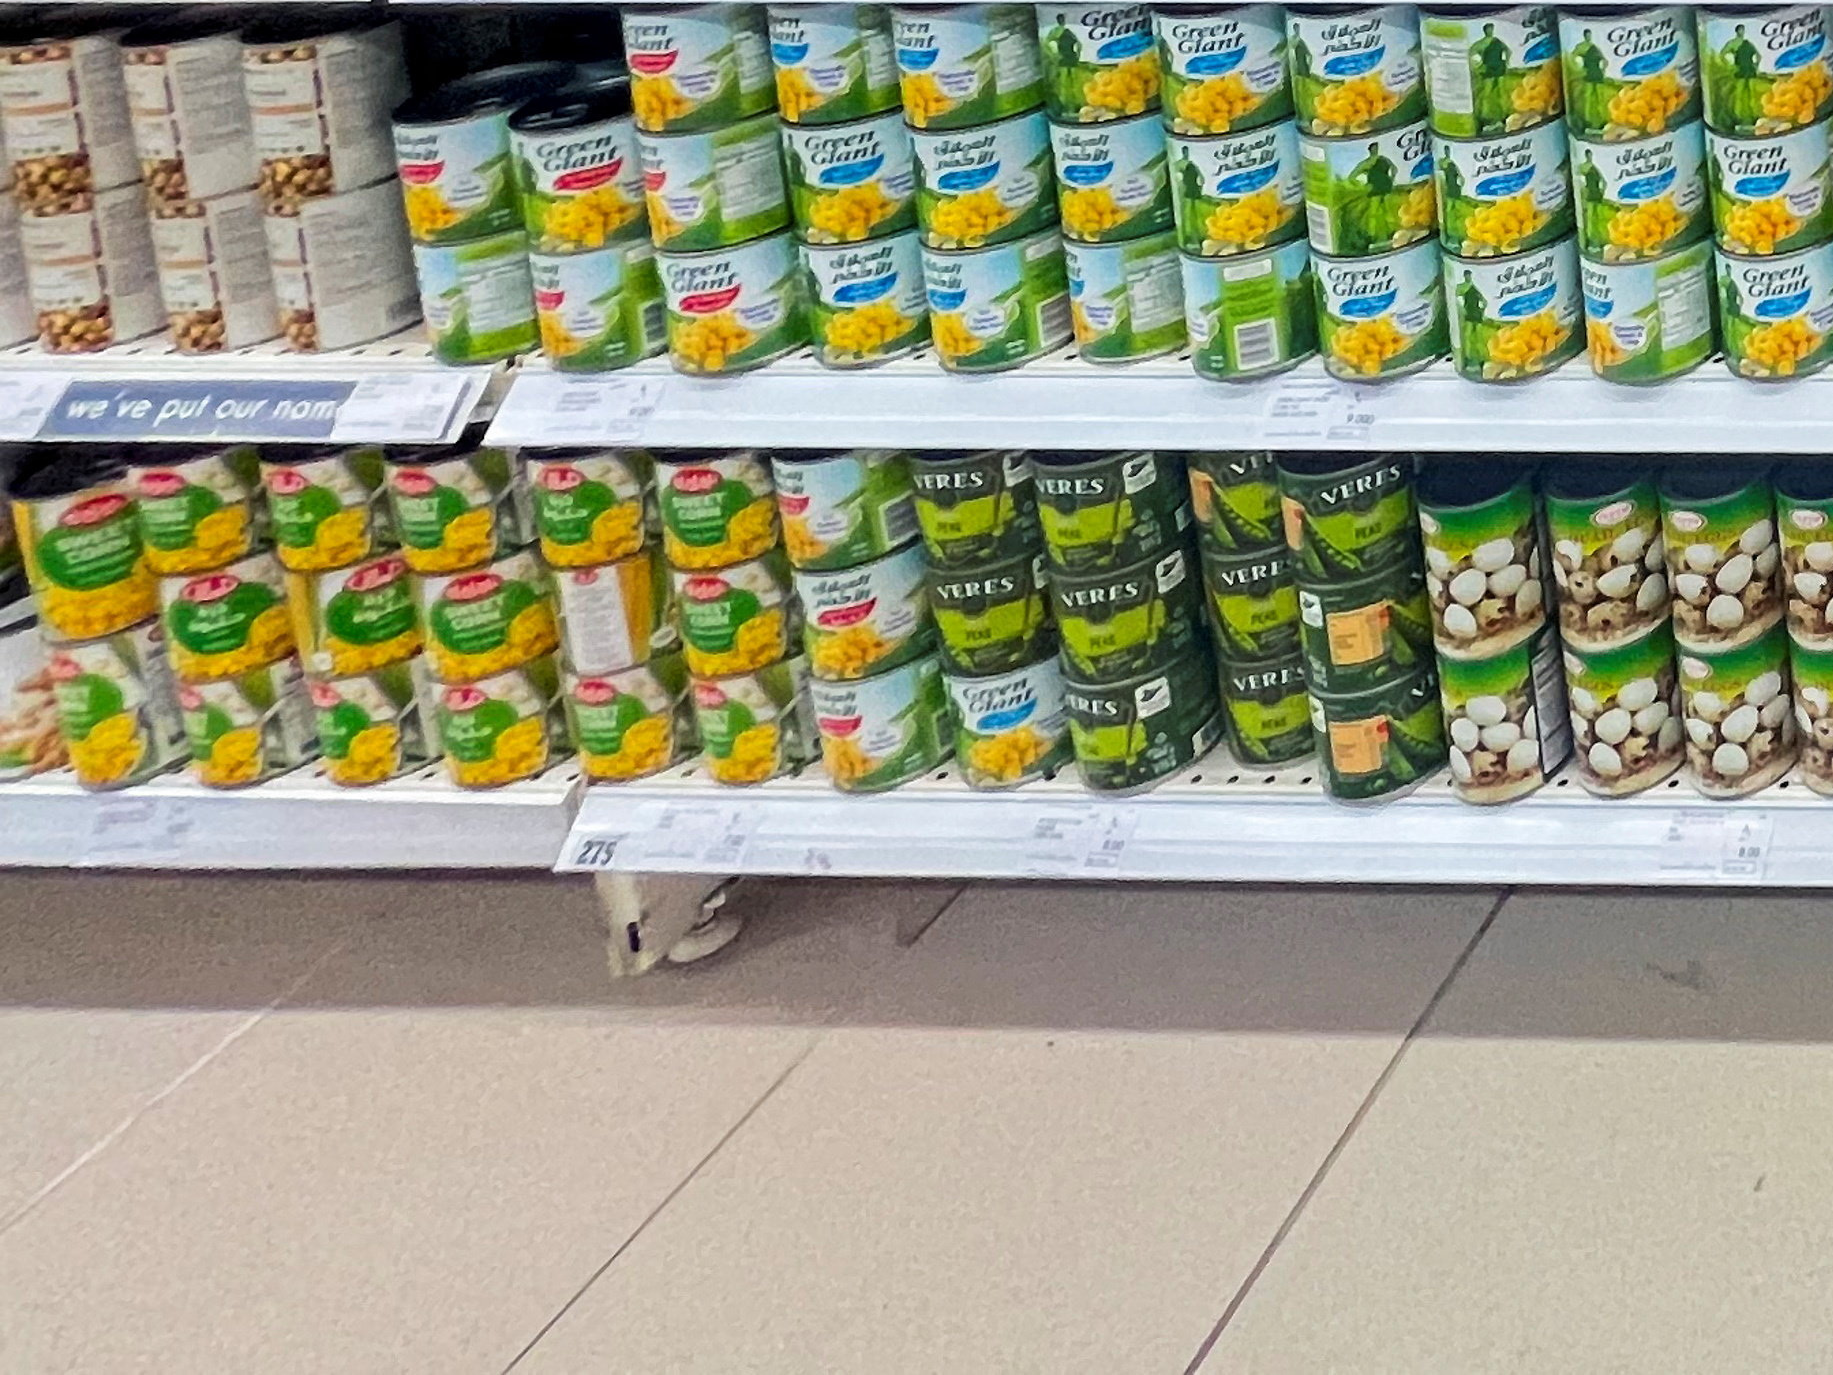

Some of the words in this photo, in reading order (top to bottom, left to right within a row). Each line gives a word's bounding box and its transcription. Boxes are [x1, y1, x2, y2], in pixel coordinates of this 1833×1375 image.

[804, 130, 875, 152] Green
[1724, 144, 1783, 164] Green
[66, 389, 153, 420] we've
[152, 393, 215, 429] put
[215, 399, 269, 420] our
[914, 470, 984, 490] VERES
[1320, 464, 1401, 505] VERES
[1060, 581, 1139, 608] VERES
[575, 843, 617, 870] 275
